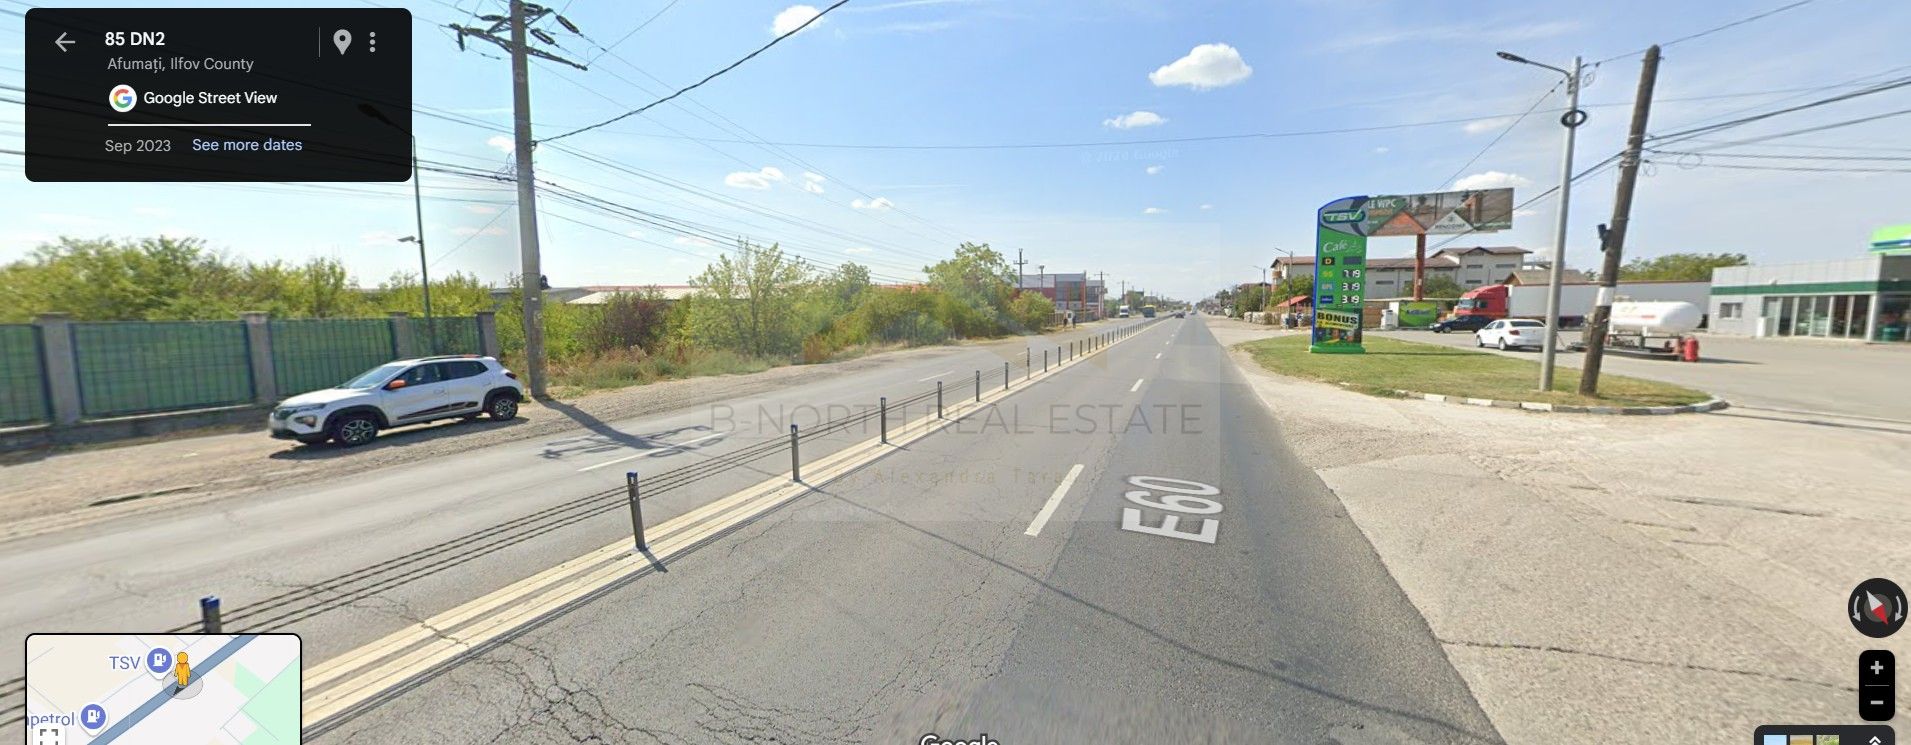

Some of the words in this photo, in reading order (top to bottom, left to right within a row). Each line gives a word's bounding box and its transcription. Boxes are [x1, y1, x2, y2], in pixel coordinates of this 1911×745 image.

[1323, 208, 1362, 222] TSV
[1317, 312, 1358, 326] BONUS
[1121, 475, 1224, 544] E60
